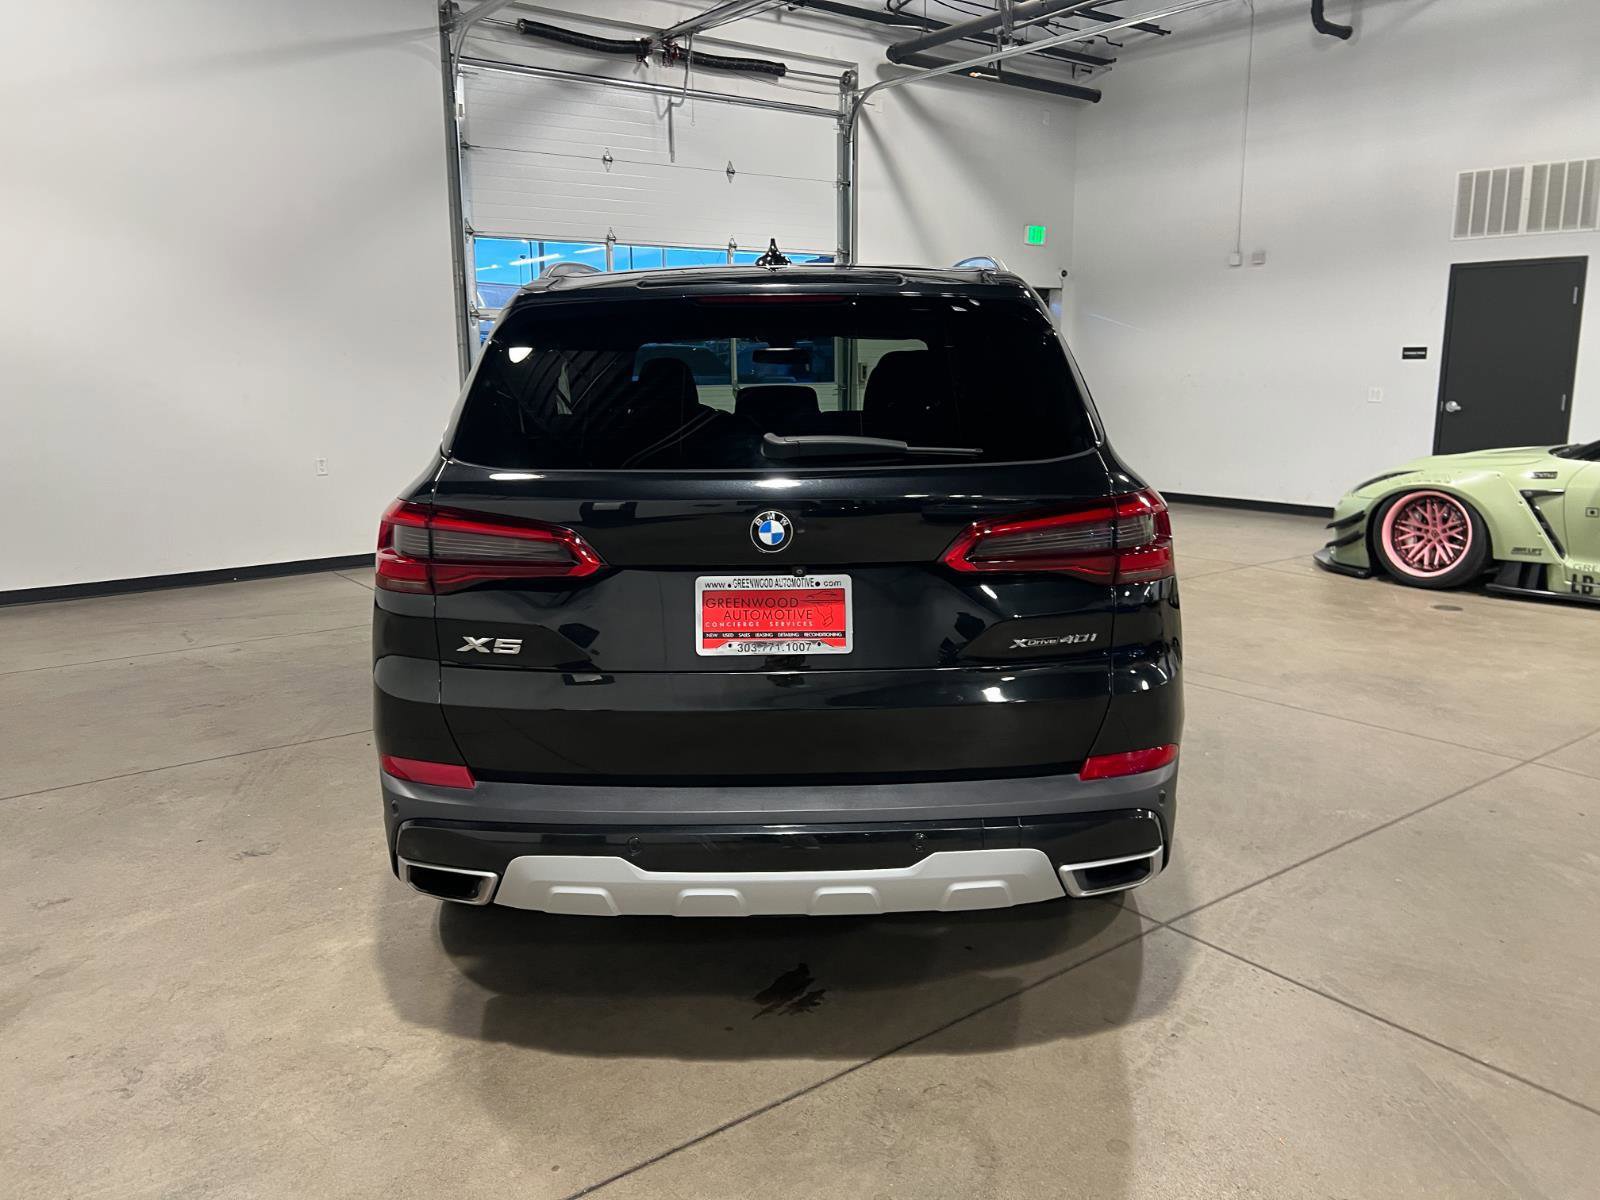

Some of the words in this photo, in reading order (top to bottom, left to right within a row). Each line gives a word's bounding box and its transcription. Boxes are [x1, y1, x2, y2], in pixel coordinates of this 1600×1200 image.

[754, 511, 789, 527] BMW
[732, 577, 774, 589] GREENWOOD
[774, 577, 815, 588] AUTOMOTIVE
[705, 597, 799, 609] GREENWOOD
[723, 609, 813, 621] AUTOMOTIVE
[456, 636, 523, 655] X5
[737, 642, 812, 653] 303.771.1007
